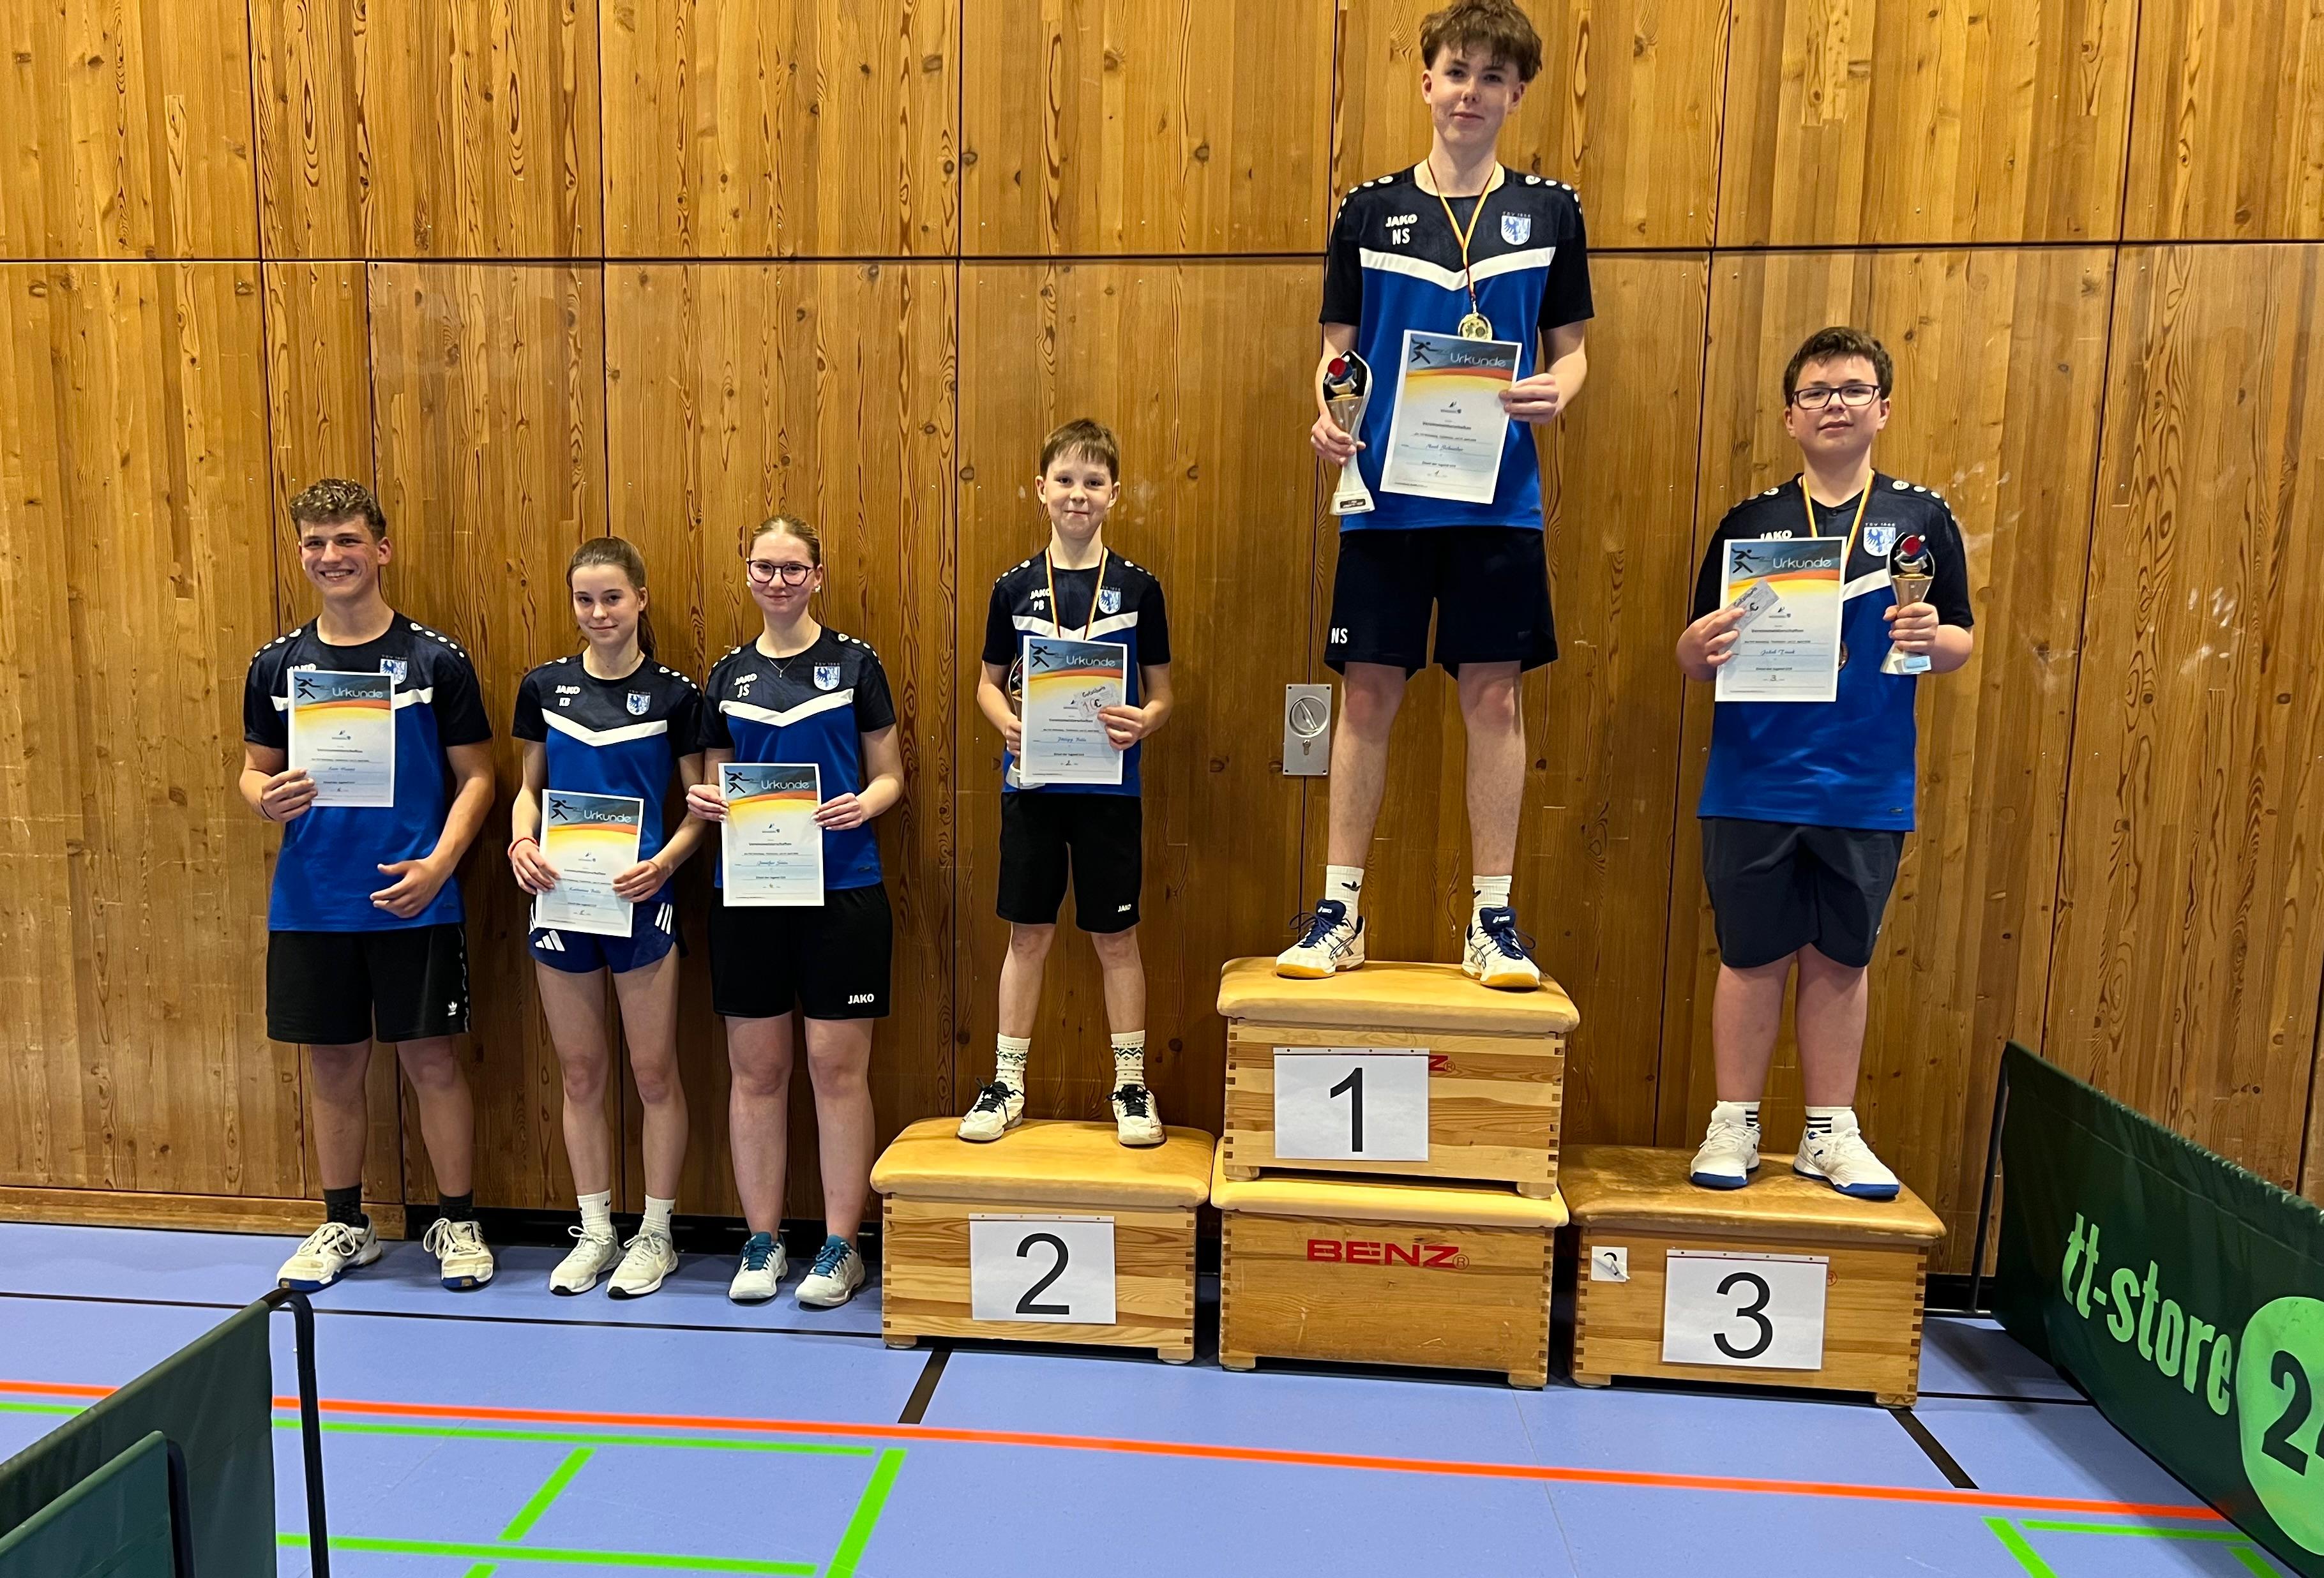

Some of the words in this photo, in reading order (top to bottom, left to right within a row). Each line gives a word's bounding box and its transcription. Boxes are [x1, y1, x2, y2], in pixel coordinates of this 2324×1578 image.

[1385, 214, 1417, 227] JAKO
[1392, 228, 1410, 245] NS
[1450, 352, 1506, 367] Urkunde
[1772, 557, 1832, 569] Urkunde
[1033, 599, 1045, 611] PB
[1331, 627, 1348, 644] NS
[1066, 655, 1116, 667] Urkunde
[332, 687, 383, 699] Urkunde
[737, 684, 750, 698] JS
[760, 779, 810, 790] Urkunde
[583, 809, 631, 823] Urkunde
[848, 993, 875, 1004] JAKO
[1330, 1067, 1363, 1153] 1
[1307, 1238, 1460, 1269] BENZ
[1015, 1232, 1070, 1316] 2
[1713, 1272, 1774, 1360] 3
[2062, 1211, 2234, 1416] tt-store
[2261, 1349, 2324, 1477] 2
